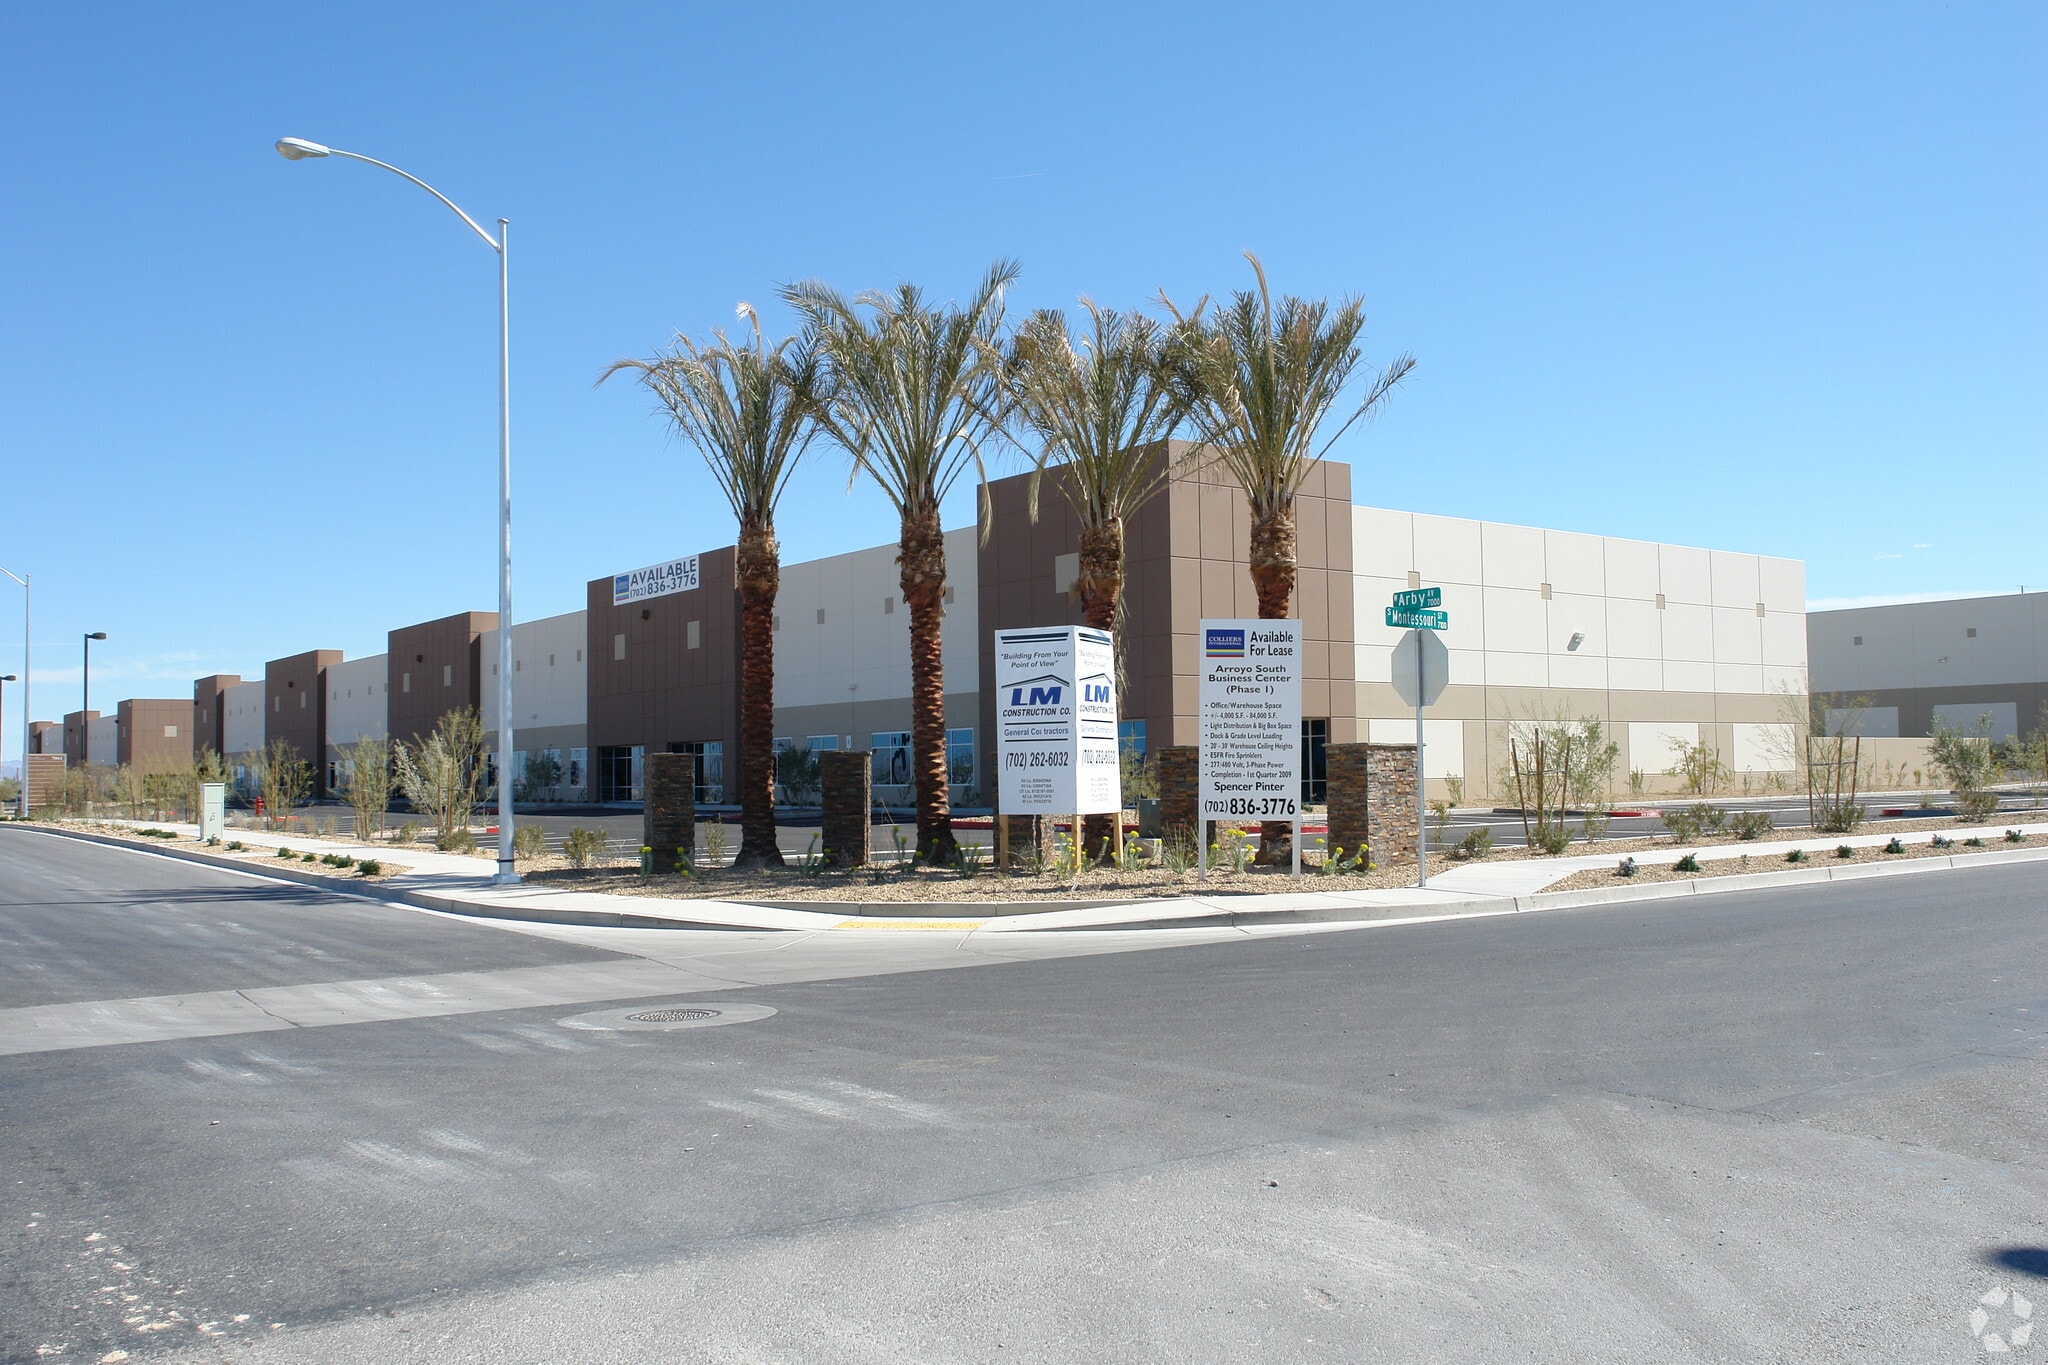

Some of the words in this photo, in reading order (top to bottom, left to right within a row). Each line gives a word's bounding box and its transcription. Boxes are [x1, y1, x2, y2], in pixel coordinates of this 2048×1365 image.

[630, 559, 696, 586] AVAILABLE
[630, 586, 646, 598] (702)
[648, 574, 696, 594] 836-3776
[1398, 592, 1425, 606] Arby
[1427, 589, 1434, 597] AV
[1392, 609, 1436, 627] Montessouri
[1250, 630, 1293, 642] Available
[1250, 644, 1265, 656] For
[1268, 644, 1293, 656] Lease
[1001, 652, 1032, 660] "Building
[1215, 665, 1252, 674] Arroyo
[1209, 674, 1252, 682] Business
[1255, 674, 1291, 682] Center
[1085, 684, 1109, 703] LM
[1226, 685, 1260, 695] (Phase
[1011, 687, 1062, 706] LM
[1080, 705, 1108, 714] CONSTRUCTION
[1264, 702, 1282, 710] Space
[1003, 708, 1056, 717] CONSTRUCTION
[1004, 728, 1029, 736] General
[1262, 732, 1282, 740] Loading
[1275, 743, 1293, 751] Heights
[1236, 752, 1262, 760] Sprinklers
[1006, 752, 1027, 771] (702)
[1030, 752, 1069, 767] 262-6032
[1211, 771, 1242, 779] Completion
[1214, 782, 1253, 793] Spencer
[1256, 782, 1285, 791] Pinter
[1205, 799, 1228, 813] (702)
[1230, 798, 1295, 815] 836-3776
